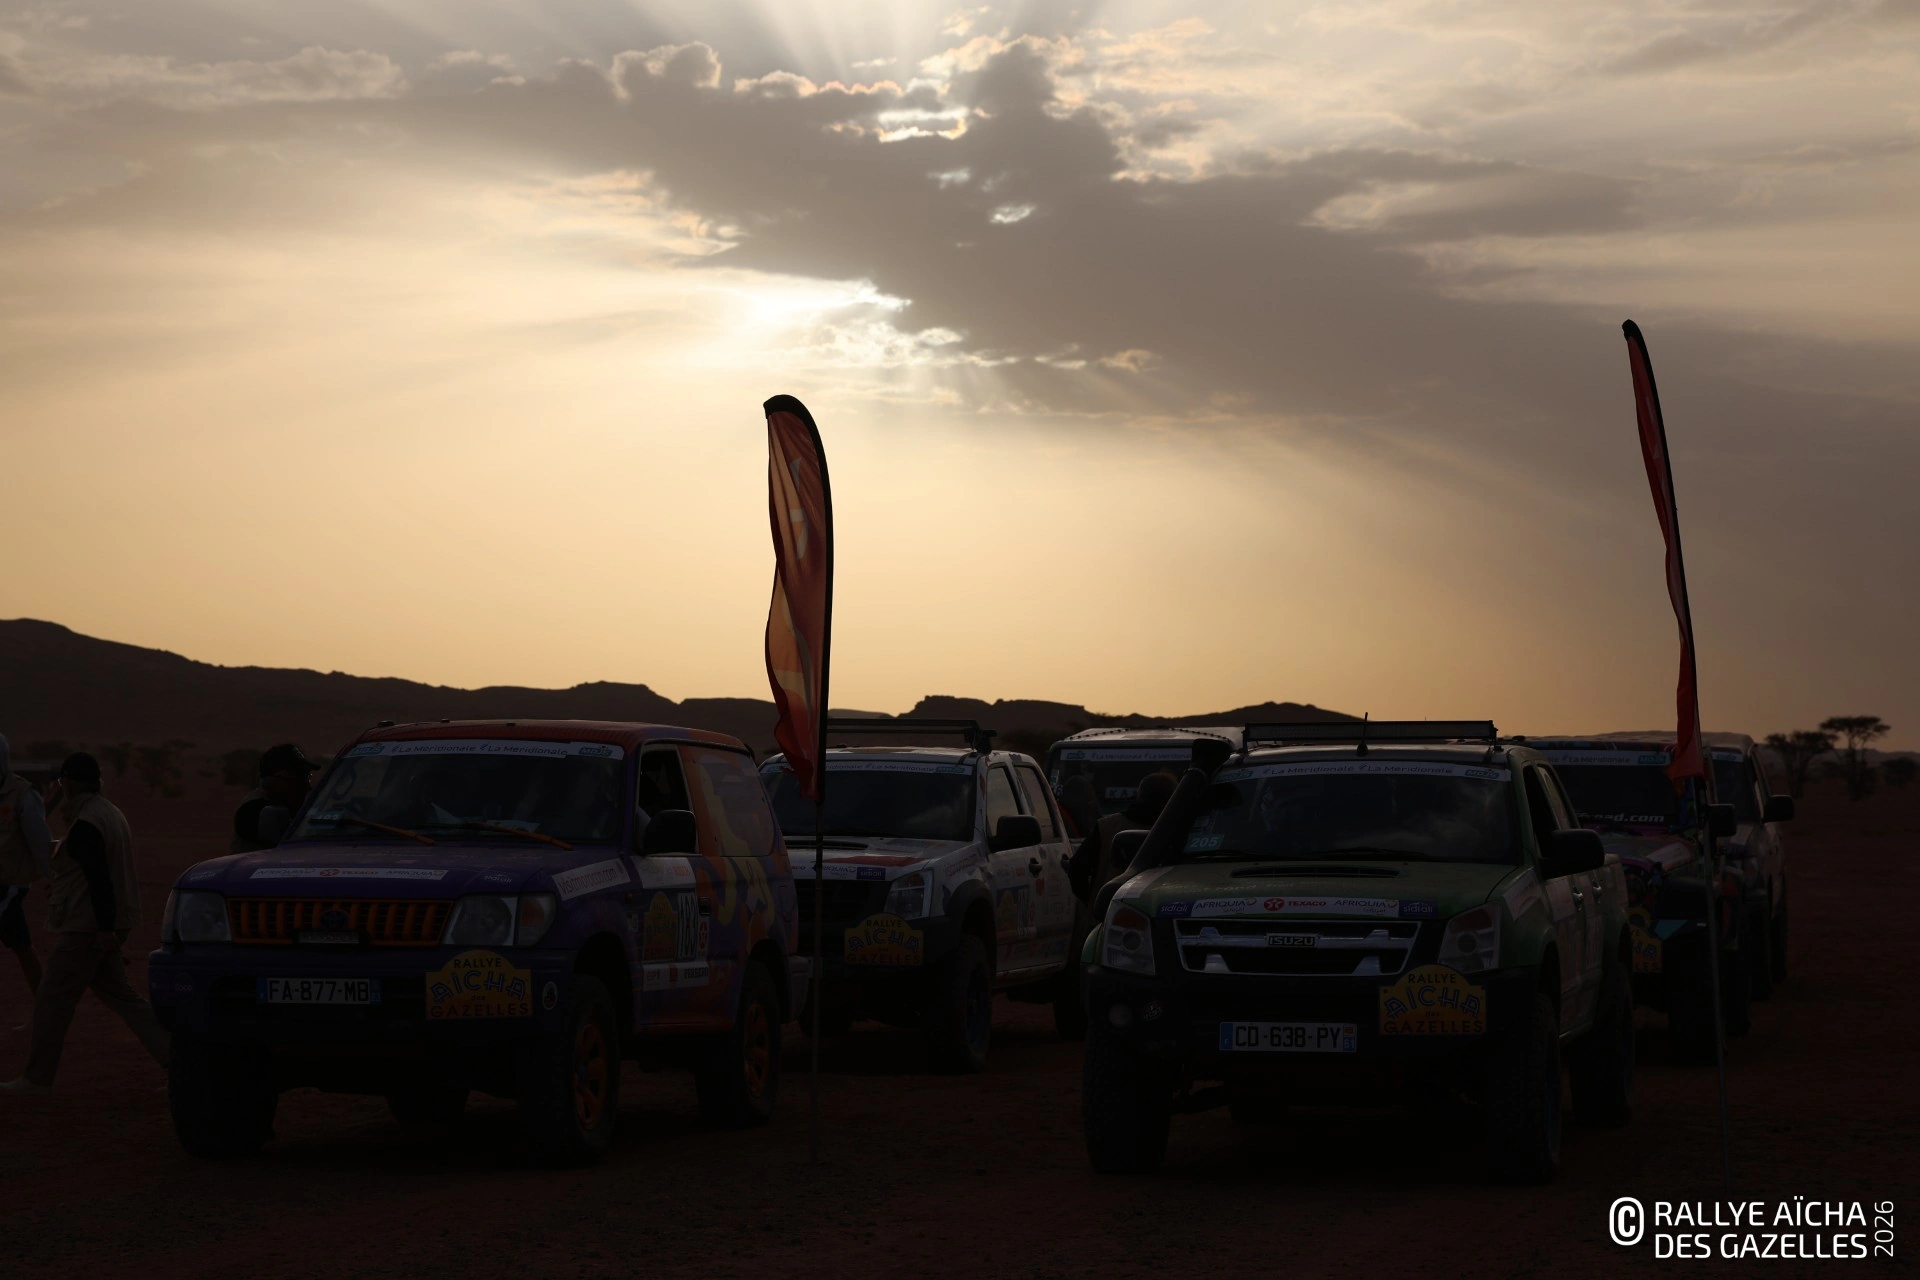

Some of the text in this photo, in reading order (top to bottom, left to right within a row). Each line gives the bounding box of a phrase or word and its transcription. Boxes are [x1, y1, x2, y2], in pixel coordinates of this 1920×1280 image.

[1190, 837, 1219, 848] 205
[1195, 900, 1246, 910] AFRIQUIA
[1333, 900, 1386, 908] AFRIQUIA
[867, 919, 903, 928] RALLYE
[1269, 936, 1314, 946] ISUZU
[453, 958, 502, 968] RALLYE
[847, 953, 921, 964] GAZELLES
[1408, 974, 1457, 983] RALLYE
[269, 980, 369, 1001] FA-877-MB
[430, 1003, 528, 1017] GAZELLES
[1384, 1021, 1483, 1033] GAZELLES
[1236, 1026, 1340, 1048] CD-638-PY
[1343, 1039, 1355, 1049] 61
